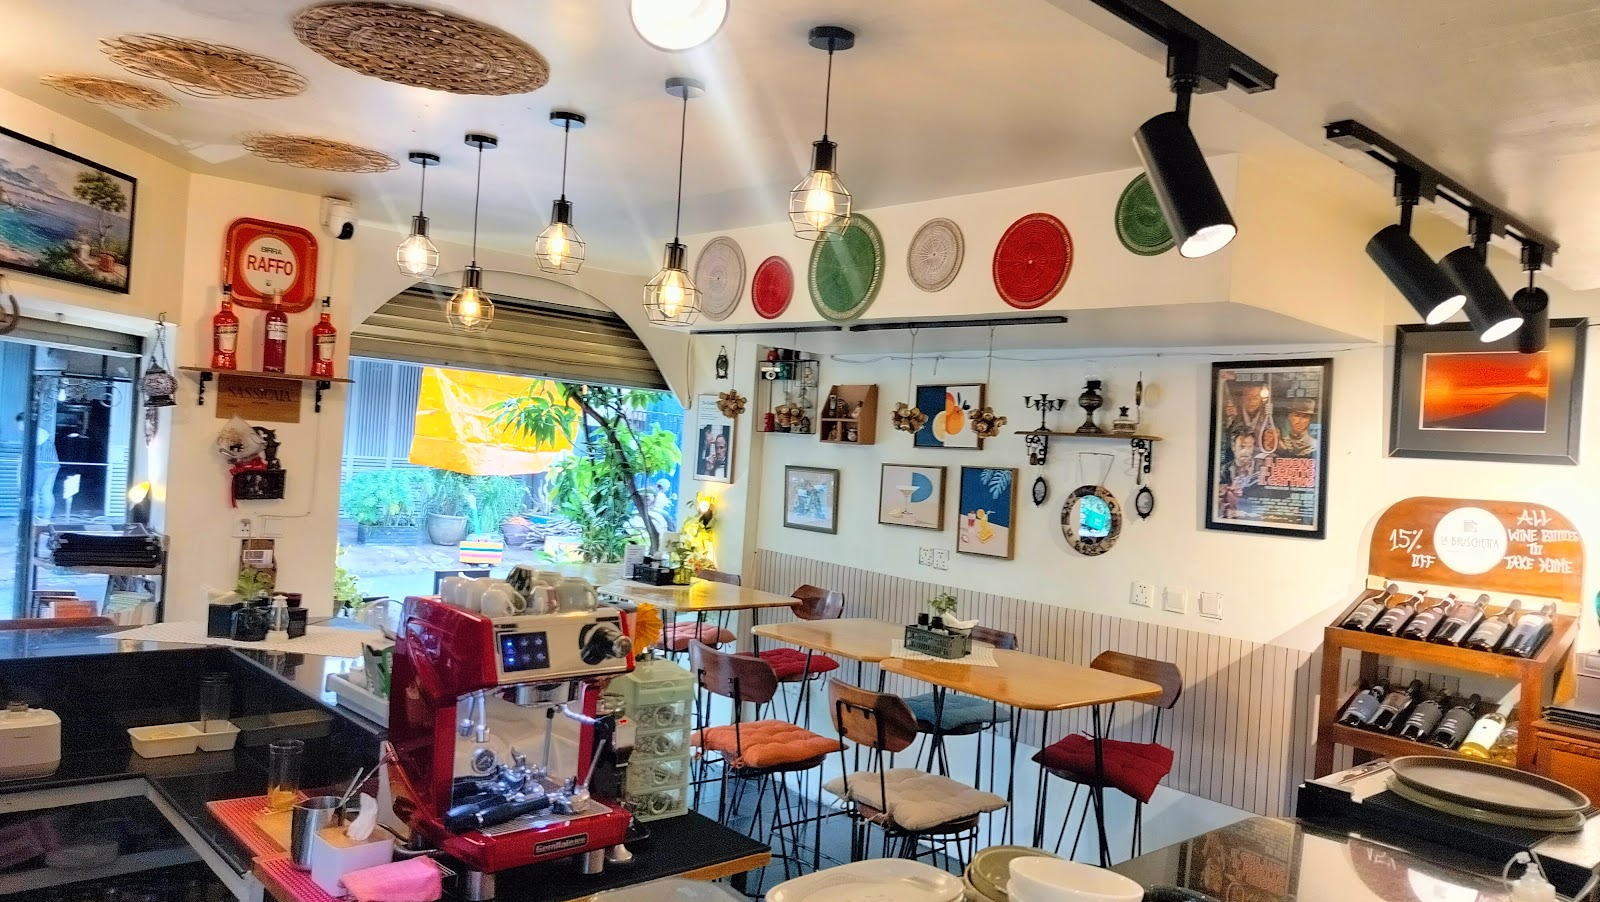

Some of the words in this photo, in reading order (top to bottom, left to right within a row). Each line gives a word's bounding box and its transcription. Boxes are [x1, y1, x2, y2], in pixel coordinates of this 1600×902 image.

[261, 246, 283, 255] BIRRA
[247, 254, 294, 275] RAFFO
[1276, 458, 1316, 468] BUONO
[1271, 467, 1316, 478] BRUTTO
[1268, 476, 1316, 488] CATTIVO
[1517, 509, 1552, 526] ALL
[1389, 528, 1423, 553] 15%
[1441, 536, 1449, 546] LA
[1451, 536, 1499, 549] BRUSCHETTA
[1526, 542, 1544, 556] TO
[1411, 553, 1437, 568] OFF
[1504, 555, 1535, 571] TAKE
[1538, 556, 1573, 574] HOME
